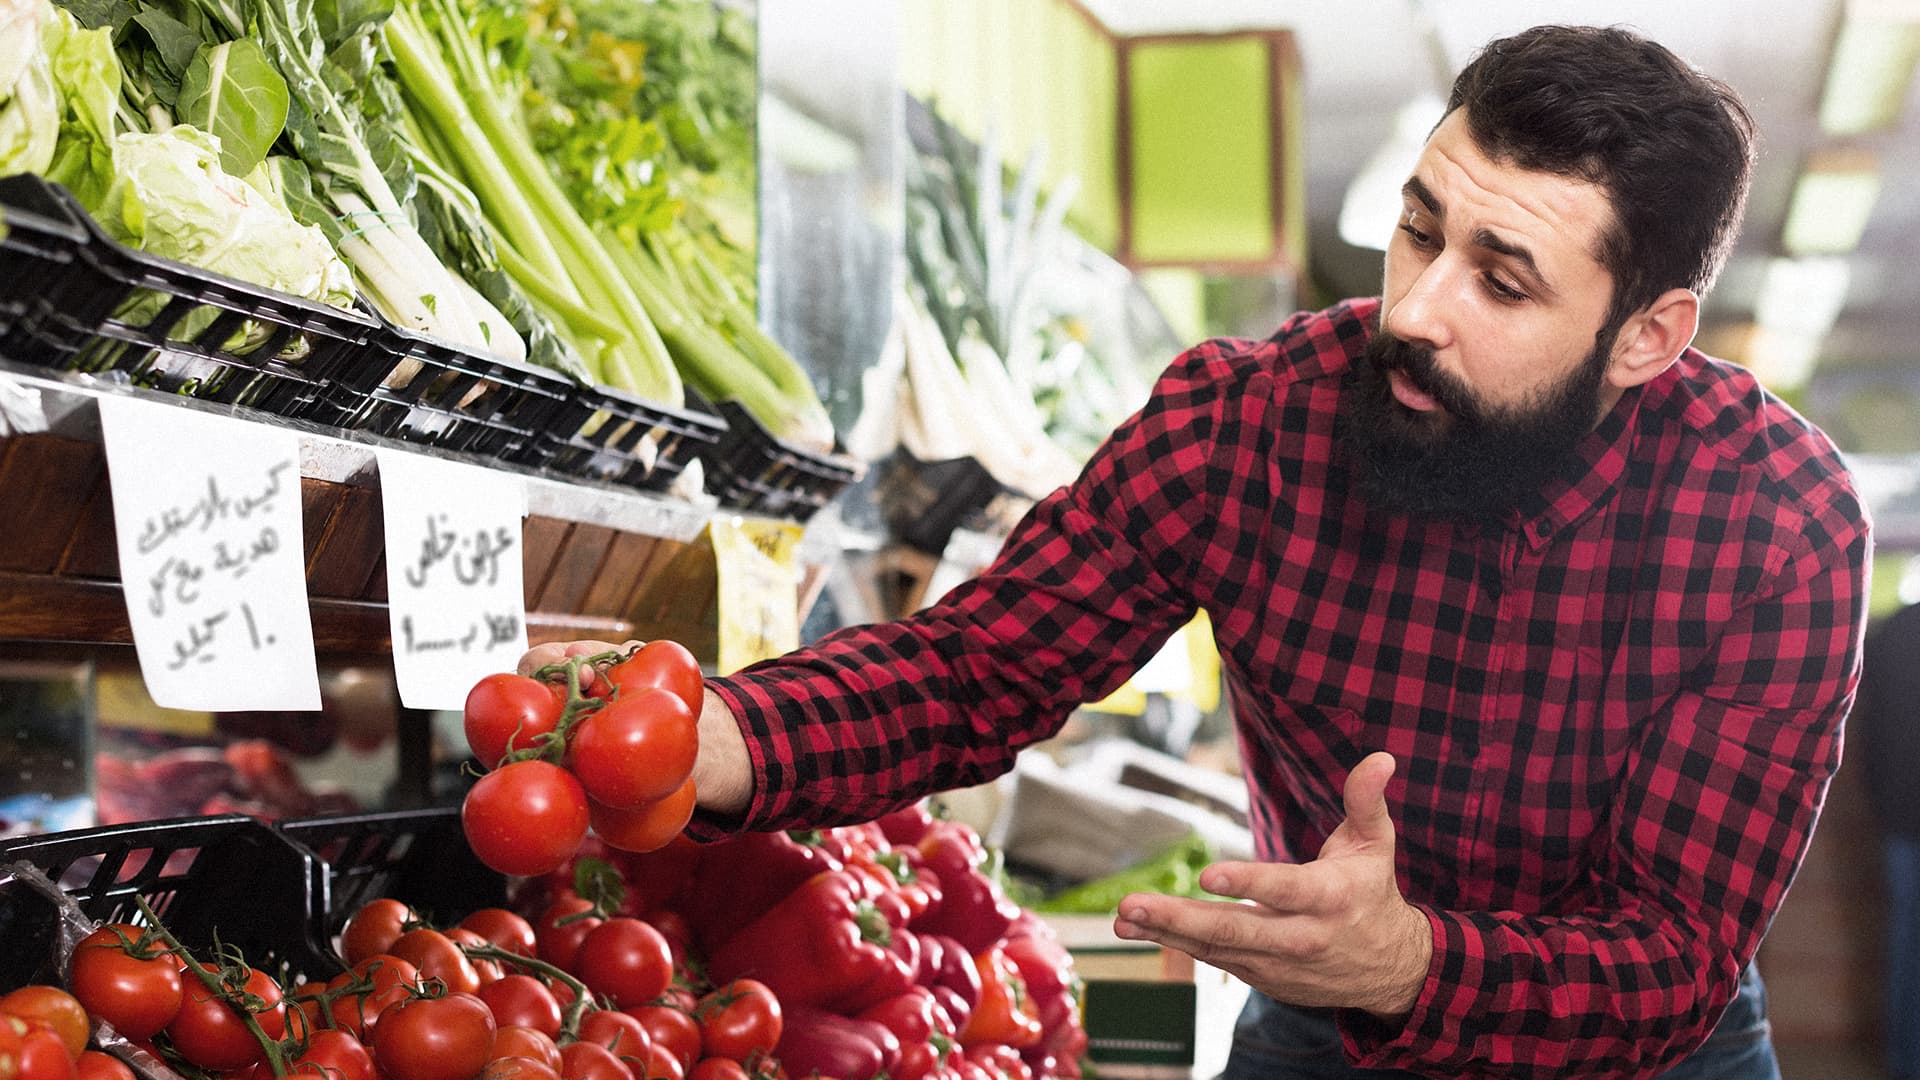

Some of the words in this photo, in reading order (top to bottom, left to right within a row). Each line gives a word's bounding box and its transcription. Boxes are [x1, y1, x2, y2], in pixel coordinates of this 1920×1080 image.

[214, 527, 280, 578] هدية
[405, 512, 457, 589] خاص
[453, 526, 515, 588] عرض
[148, 557, 177, 618] كل
[174, 558, 205, 606] مع
[168, 611, 228, 671] كيلو
